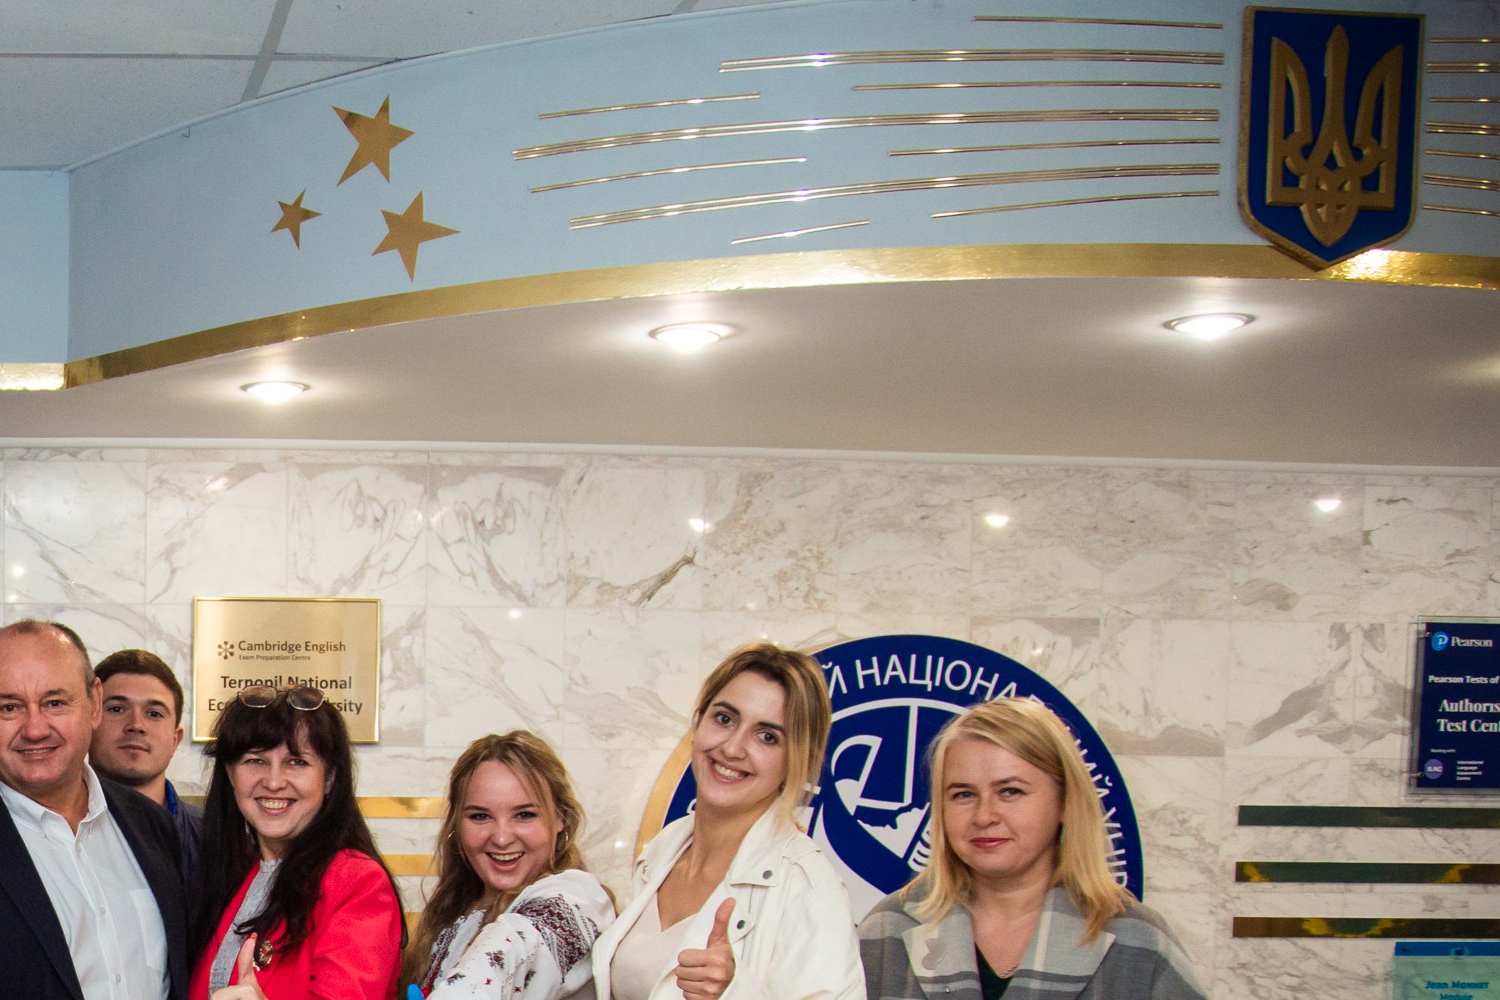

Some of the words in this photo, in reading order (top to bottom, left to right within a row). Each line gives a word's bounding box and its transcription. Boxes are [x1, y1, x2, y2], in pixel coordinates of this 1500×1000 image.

[238, 640, 301, 653] Cambridge
[305, 641, 346, 653] English
[1451, 636, 1493, 648] Pearson
[287, 676, 352, 689] National
[1428, 675, 1464, 683] Pearson
[1465, 675, 1489, 683] Tests
[1436, 718, 1467, 732] Test
